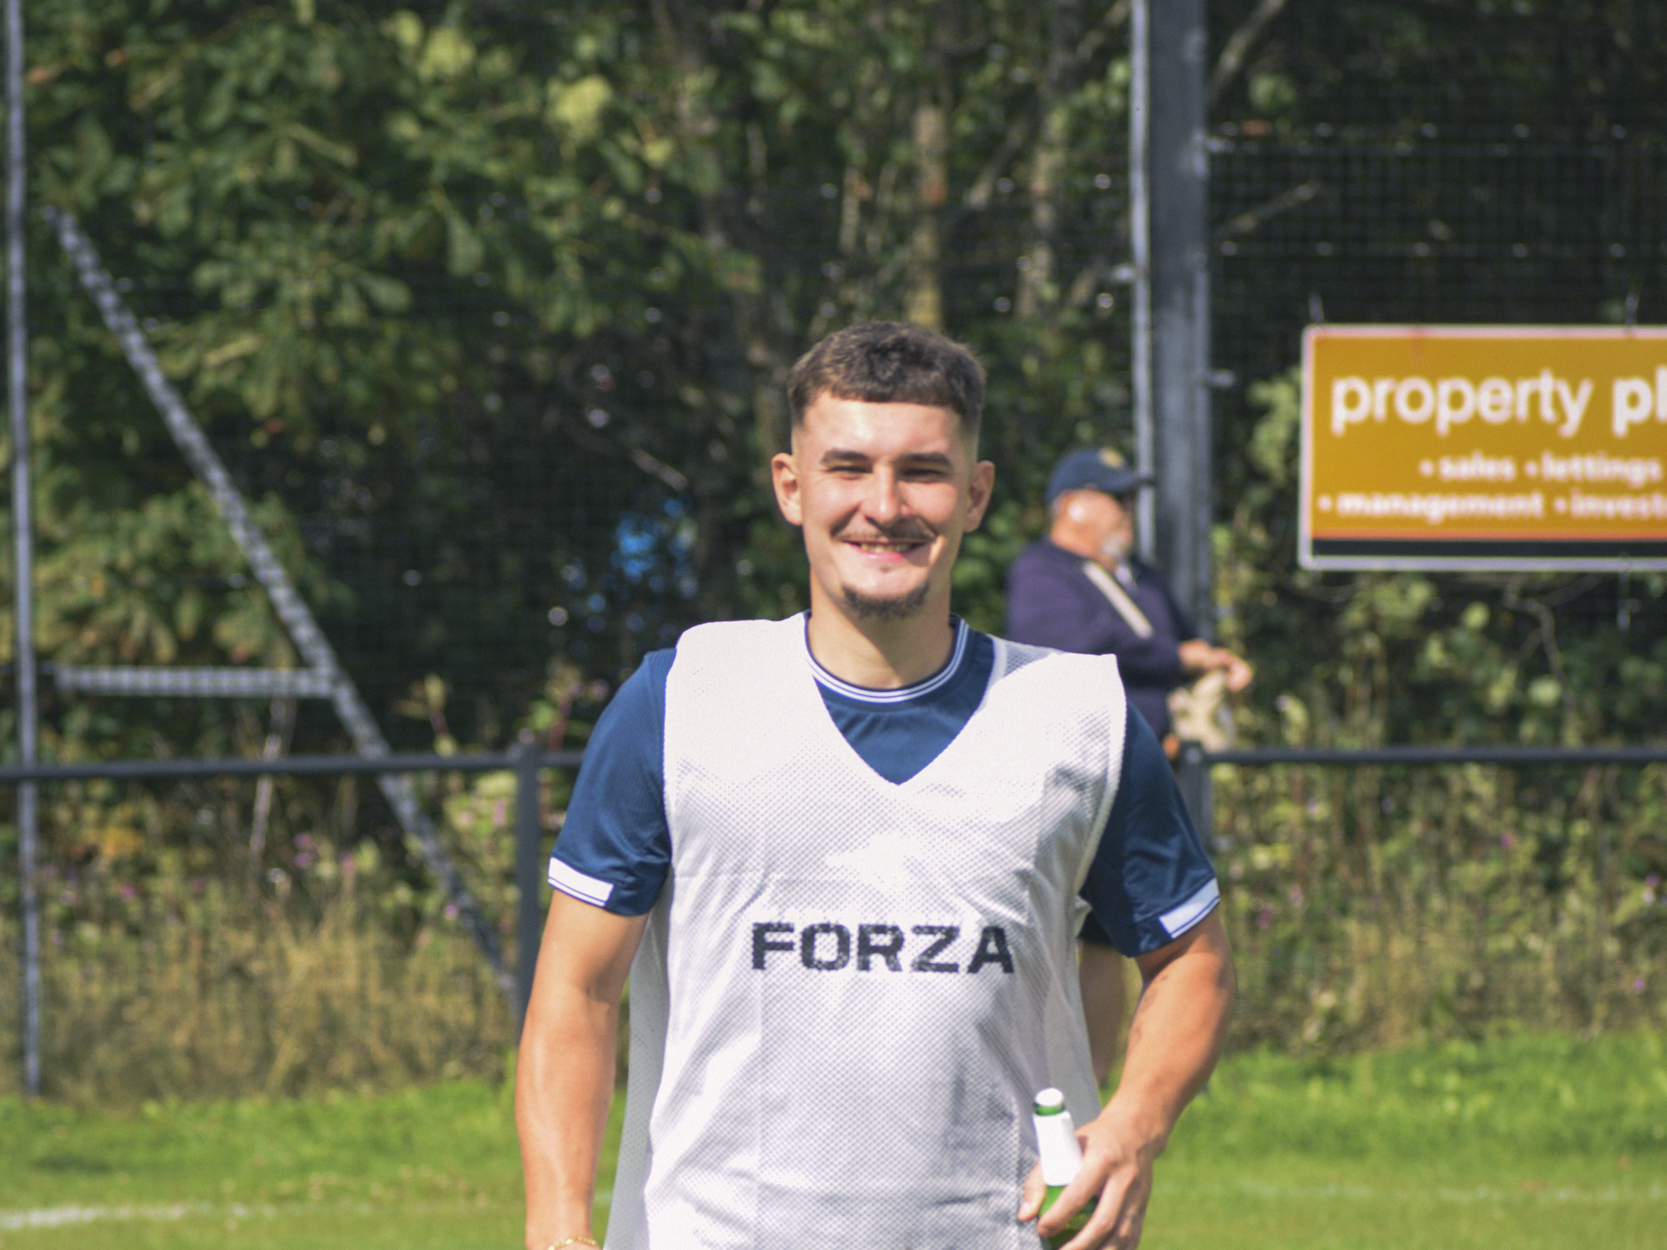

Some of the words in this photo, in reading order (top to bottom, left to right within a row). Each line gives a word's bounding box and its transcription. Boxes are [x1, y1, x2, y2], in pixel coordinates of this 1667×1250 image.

[1331, 368, 1593, 437] property
[1612, 364, 1667, 438] pl
[1438, 451, 1516, 481] sales
[1542, 451, 1662, 488] lettings
[1337, 491, 1544, 524] management
[751, 921, 1015, 974] FORZA
